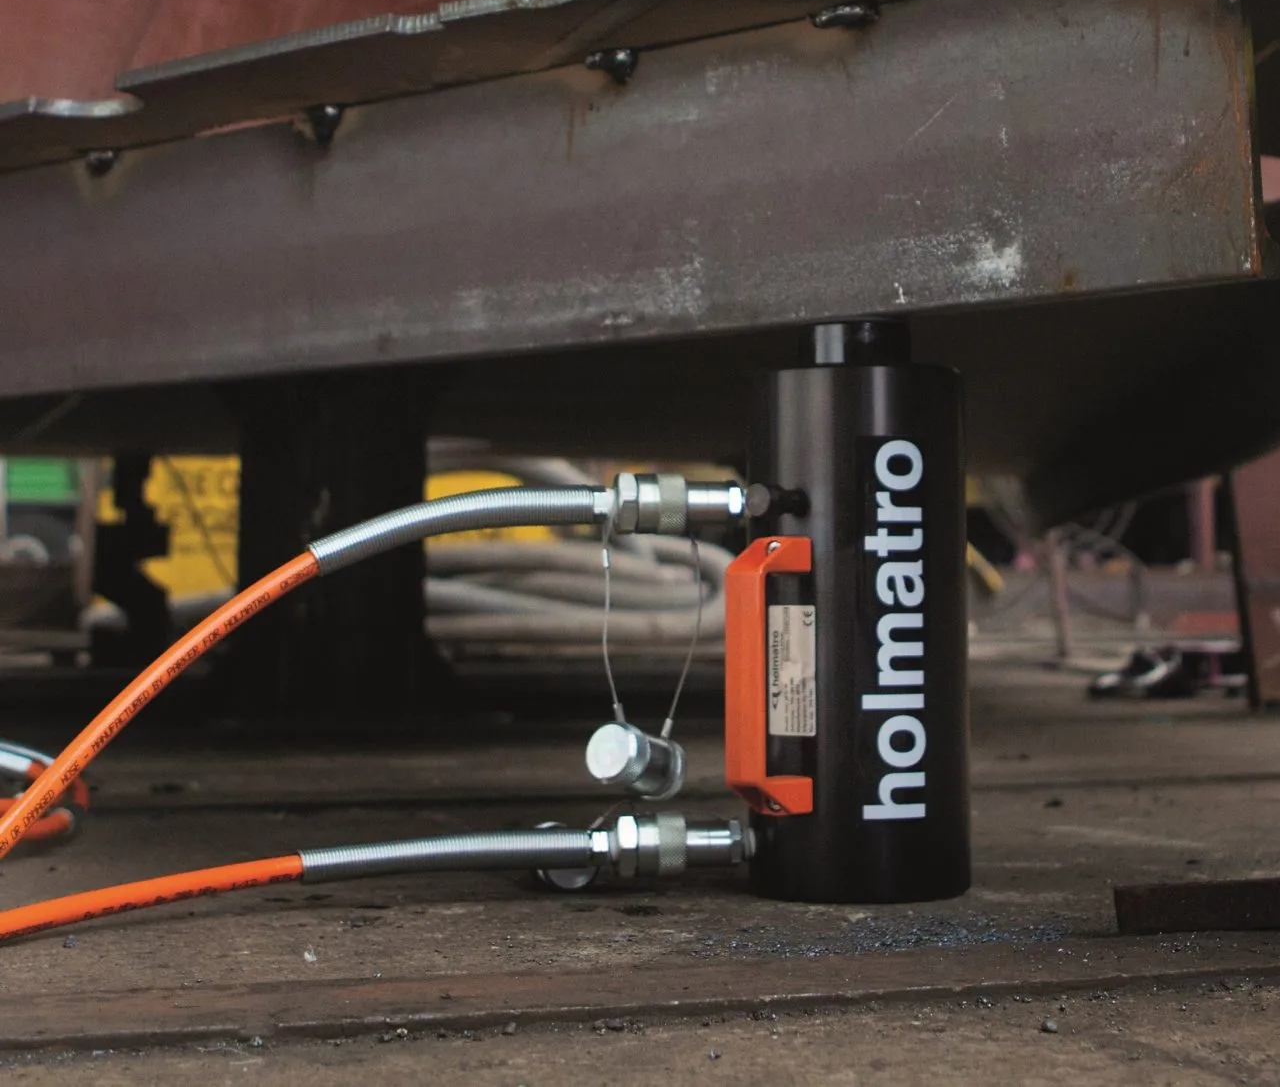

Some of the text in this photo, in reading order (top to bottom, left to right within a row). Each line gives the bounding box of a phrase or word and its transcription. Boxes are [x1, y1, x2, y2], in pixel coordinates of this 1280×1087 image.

[11, 825, 21, 841] OR
[23, 789, 55, 828] DAMAGED
[61, 760, 80, 786] HOSE
[91, 689, 150, 753] MANUFACTURED
[151, 677, 164, 692] BY
[166, 645, 200, 679] PARKER
[202, 628, 221, 649] FOR
[223, 592, 271, 632] HOLMATRO
[771, 629, 780, 688] holmatro
[862, 439, 927, 821] holmatro
